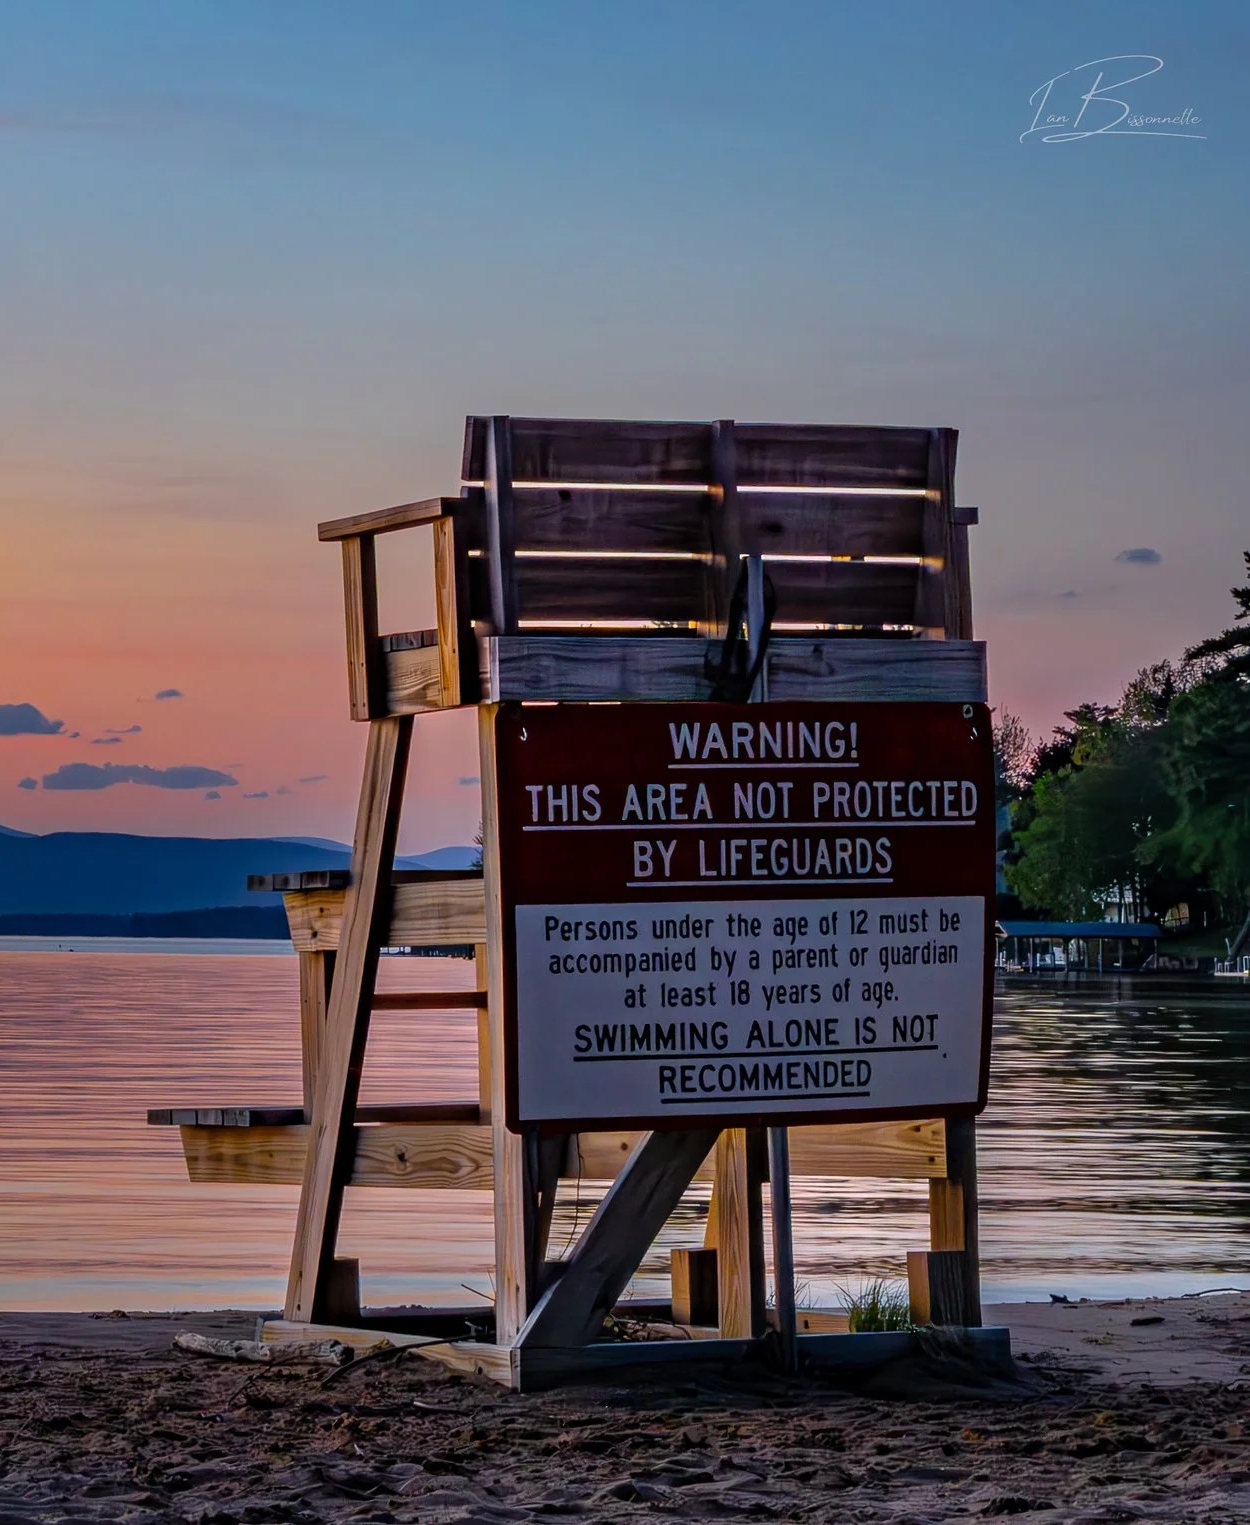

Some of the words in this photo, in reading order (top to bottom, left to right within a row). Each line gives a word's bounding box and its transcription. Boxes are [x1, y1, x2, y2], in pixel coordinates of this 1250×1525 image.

[669, 721, 858, 759] WARNING!
[525, 784, 601, 822] THIS
[622, 783, 713, 821] AREA
[734, 782, 794, 819] NOT
[814, 781, 977, 818] PROTECTED
[634, 840, 677, 877] BY
[699, 837, 893, 876] LIFEGUARDS
[544, 915, 638, 941] Persons
[652, 915, 714, 939] under
[726, 913, 761, 937] the
[773, 917, 808, 945] age
[819, 911, 838, 936] of
[850, 910, 868, 935] 12
[879, 911, 928, 934] must
[939, 908, 960, 932] be
[549, 947, 696, 978] accompanied
[711, 946, 736, 974] by
[749, 950, 760, 970] a
[772, 945, 839, 973] parent
[850, 947, 868, 967] or
[879, 940, 958, 973] guardian
[624, 985, 646, 1008] at
[661, 983, 716, 1006] least
[730, 981, 750, 1005] 18
[762, 983, 822, 1010] years
[832, 979, 850, 1002] of
[861, 983, 899, 1009] age.
[574, 1022, 728, 1053] SWIMMING
[746, 1018, 839, 1049] ALONE
[855, 1017, 876, 1044] IS
[892, 1014, 939, 1043] NOT
[659, 1060, 871, 1094] RECOMMENDED
